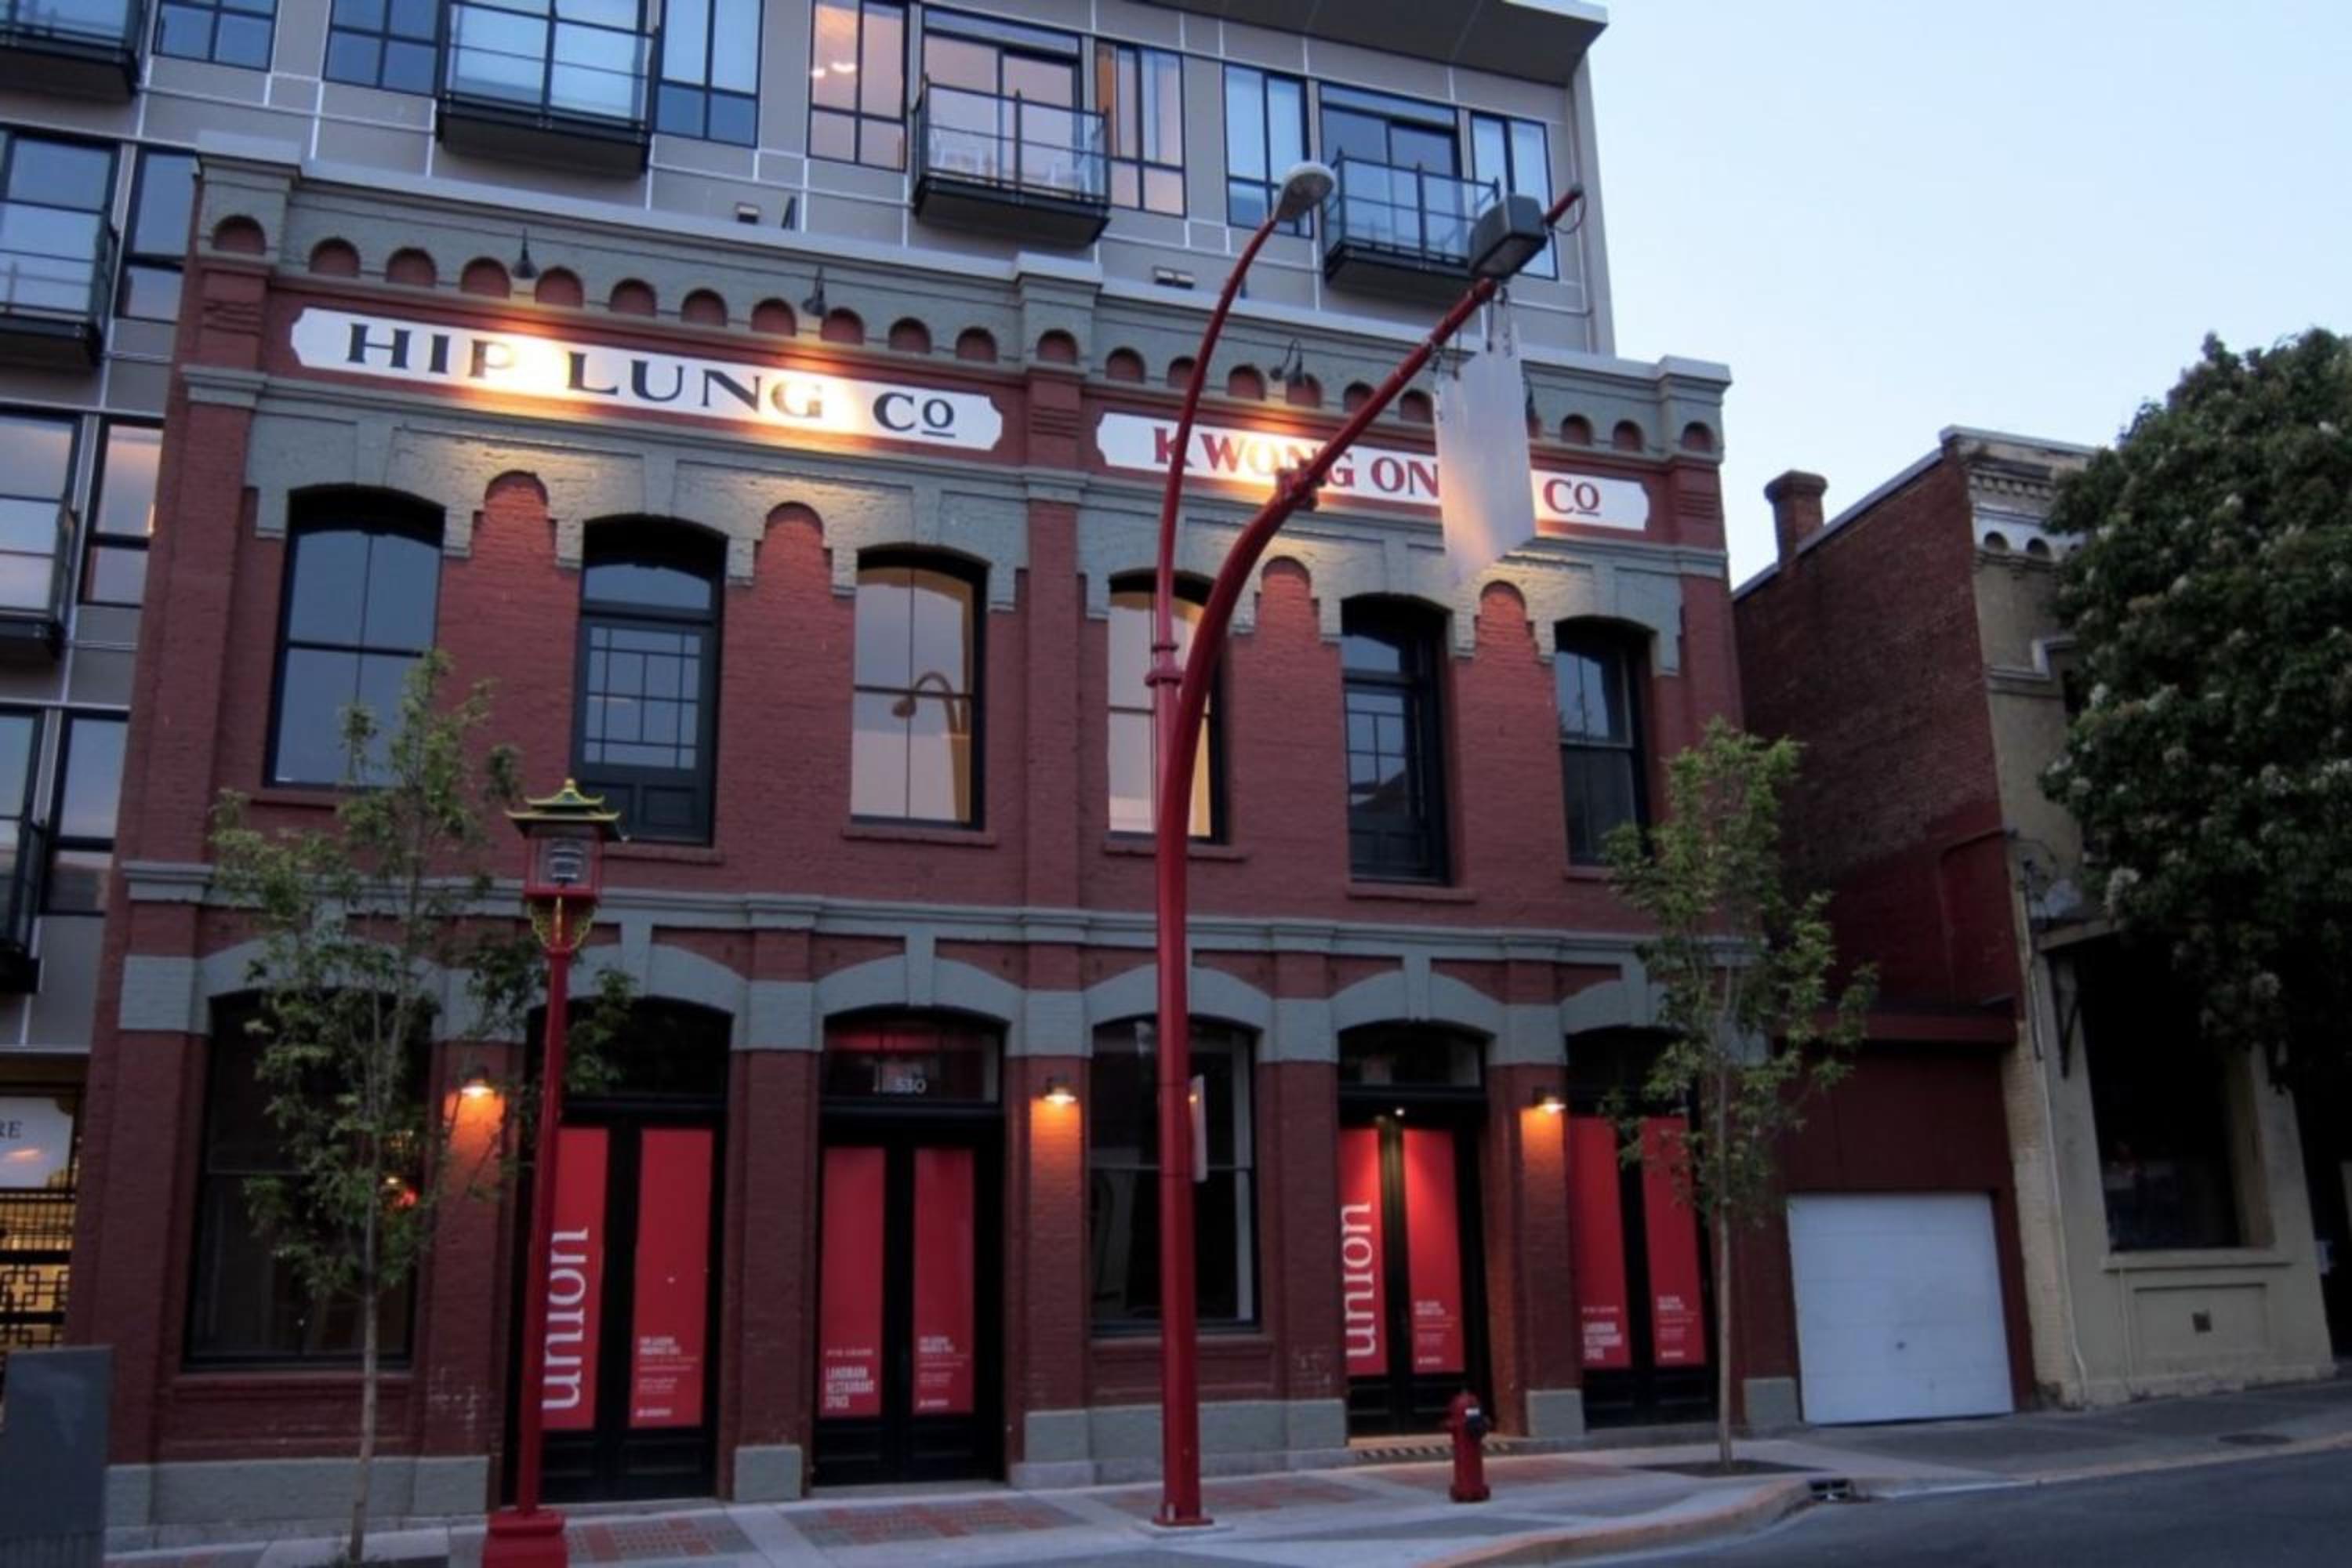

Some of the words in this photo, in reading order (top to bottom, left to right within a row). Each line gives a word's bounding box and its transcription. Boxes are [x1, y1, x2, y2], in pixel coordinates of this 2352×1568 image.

[347, 322, 514, 379] HIP
[566, 351, 822, 420] LUNG
[542, 1228, 589, 1409] union
[1341, 1202, 1376, 1357] union
